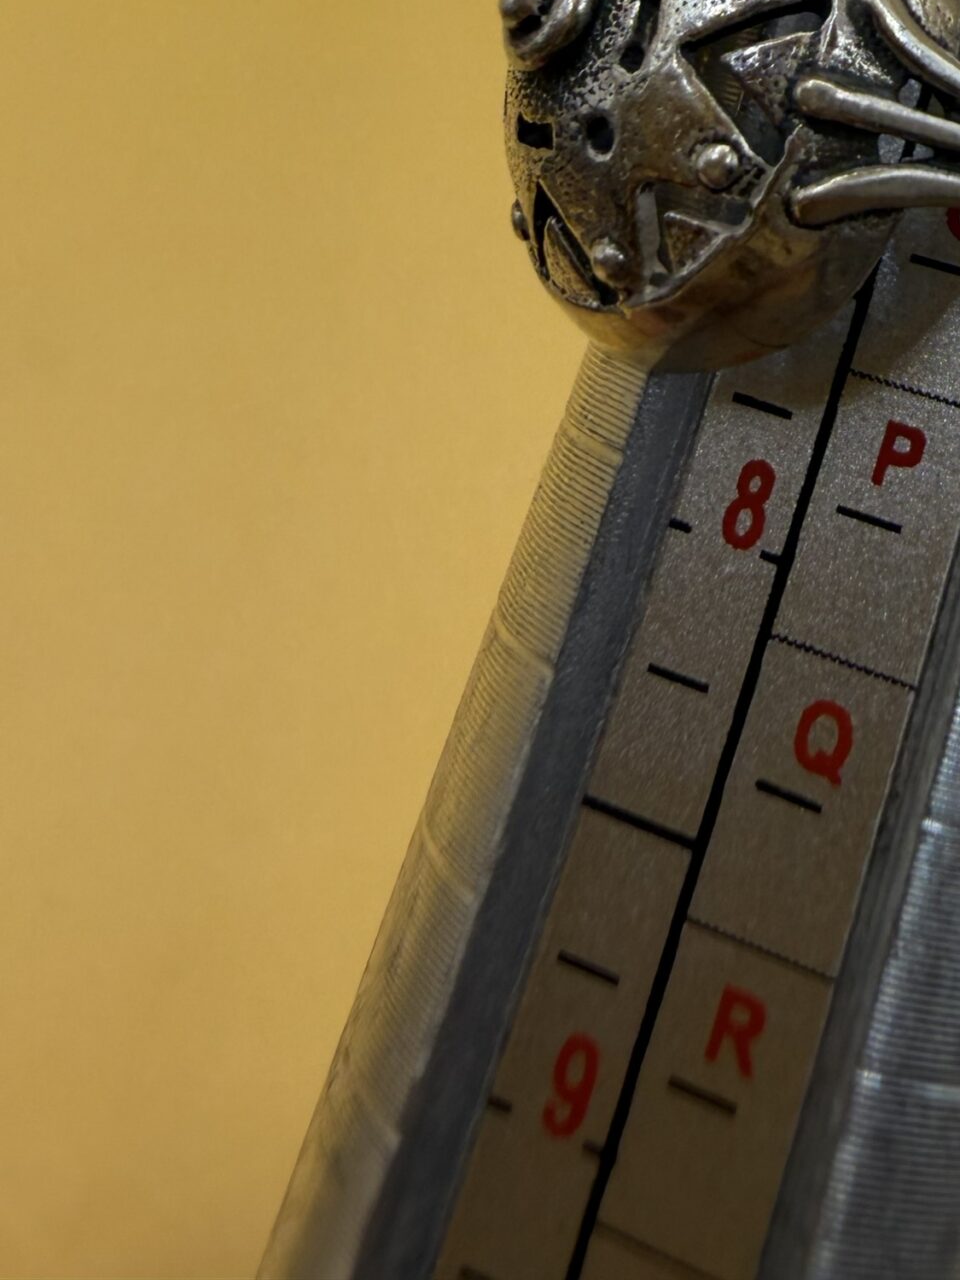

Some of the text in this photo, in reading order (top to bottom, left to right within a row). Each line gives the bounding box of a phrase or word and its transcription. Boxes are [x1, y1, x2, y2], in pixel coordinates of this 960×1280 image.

[871, 420, 926, 487] P
[722, 459, 776, 551] 8
[793, 698, 854, 787] Q
[704, 984, 767, 1079] R
[541, 1033, 601, 1140] 9
